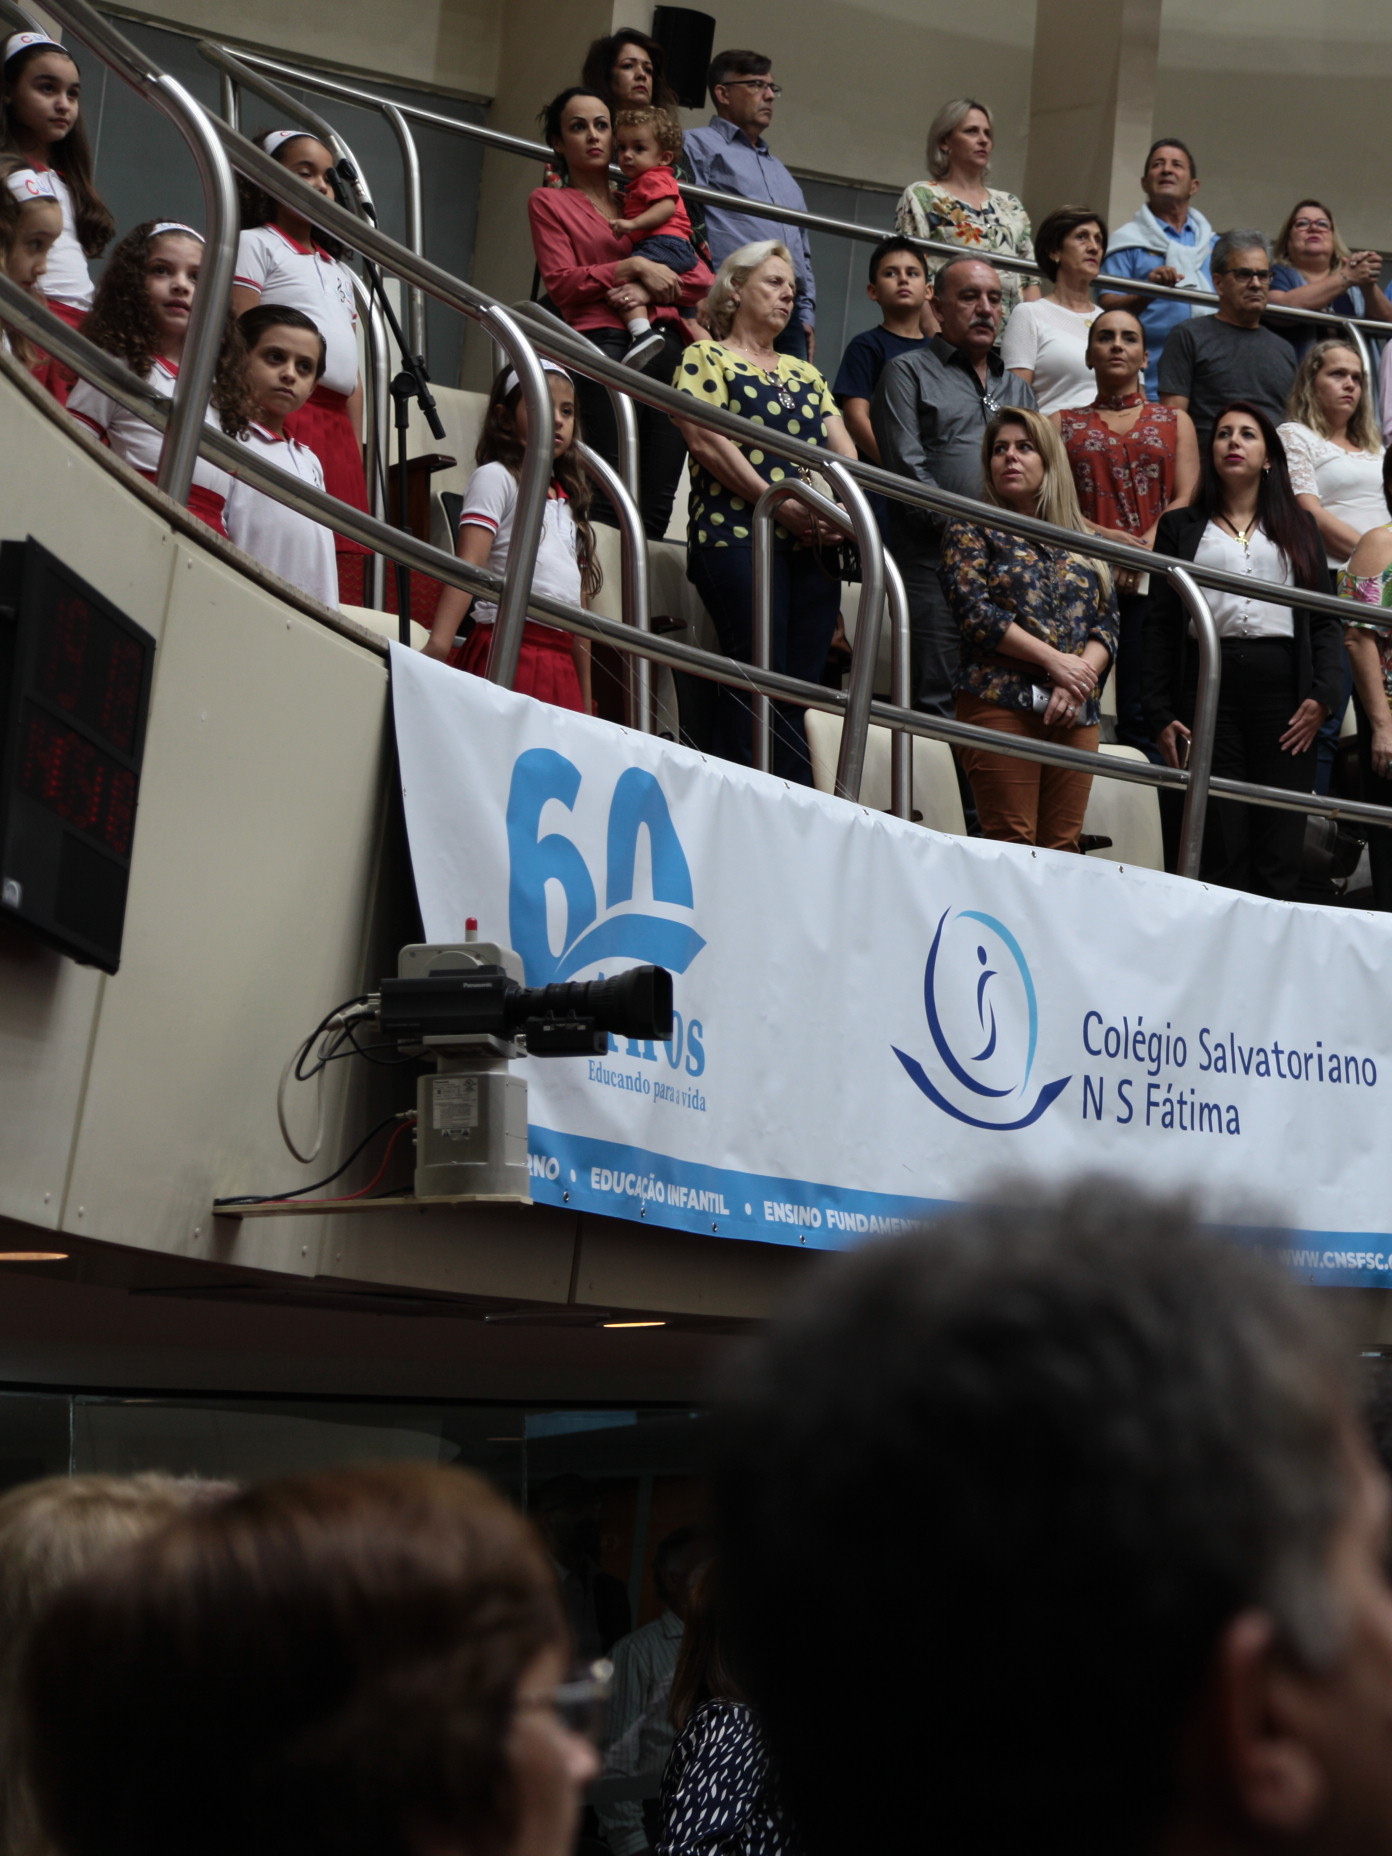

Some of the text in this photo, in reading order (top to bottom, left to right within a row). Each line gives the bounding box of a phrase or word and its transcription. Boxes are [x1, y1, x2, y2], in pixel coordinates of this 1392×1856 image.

[505, 747, 706, 984] 60
[1082, 1010, 1378, 1088] Colégio Salvatoriano
[588, 1059, 707, 1112] Educando para a vida
[1082, 1074, 1241, 1136] N S Fátima
[590, 1167, 665, 1203] EDUCAÇÃO
[667, 1183, 730, 1216] INFANTIL
[763, 1200, 822, 1229] ENSINO
